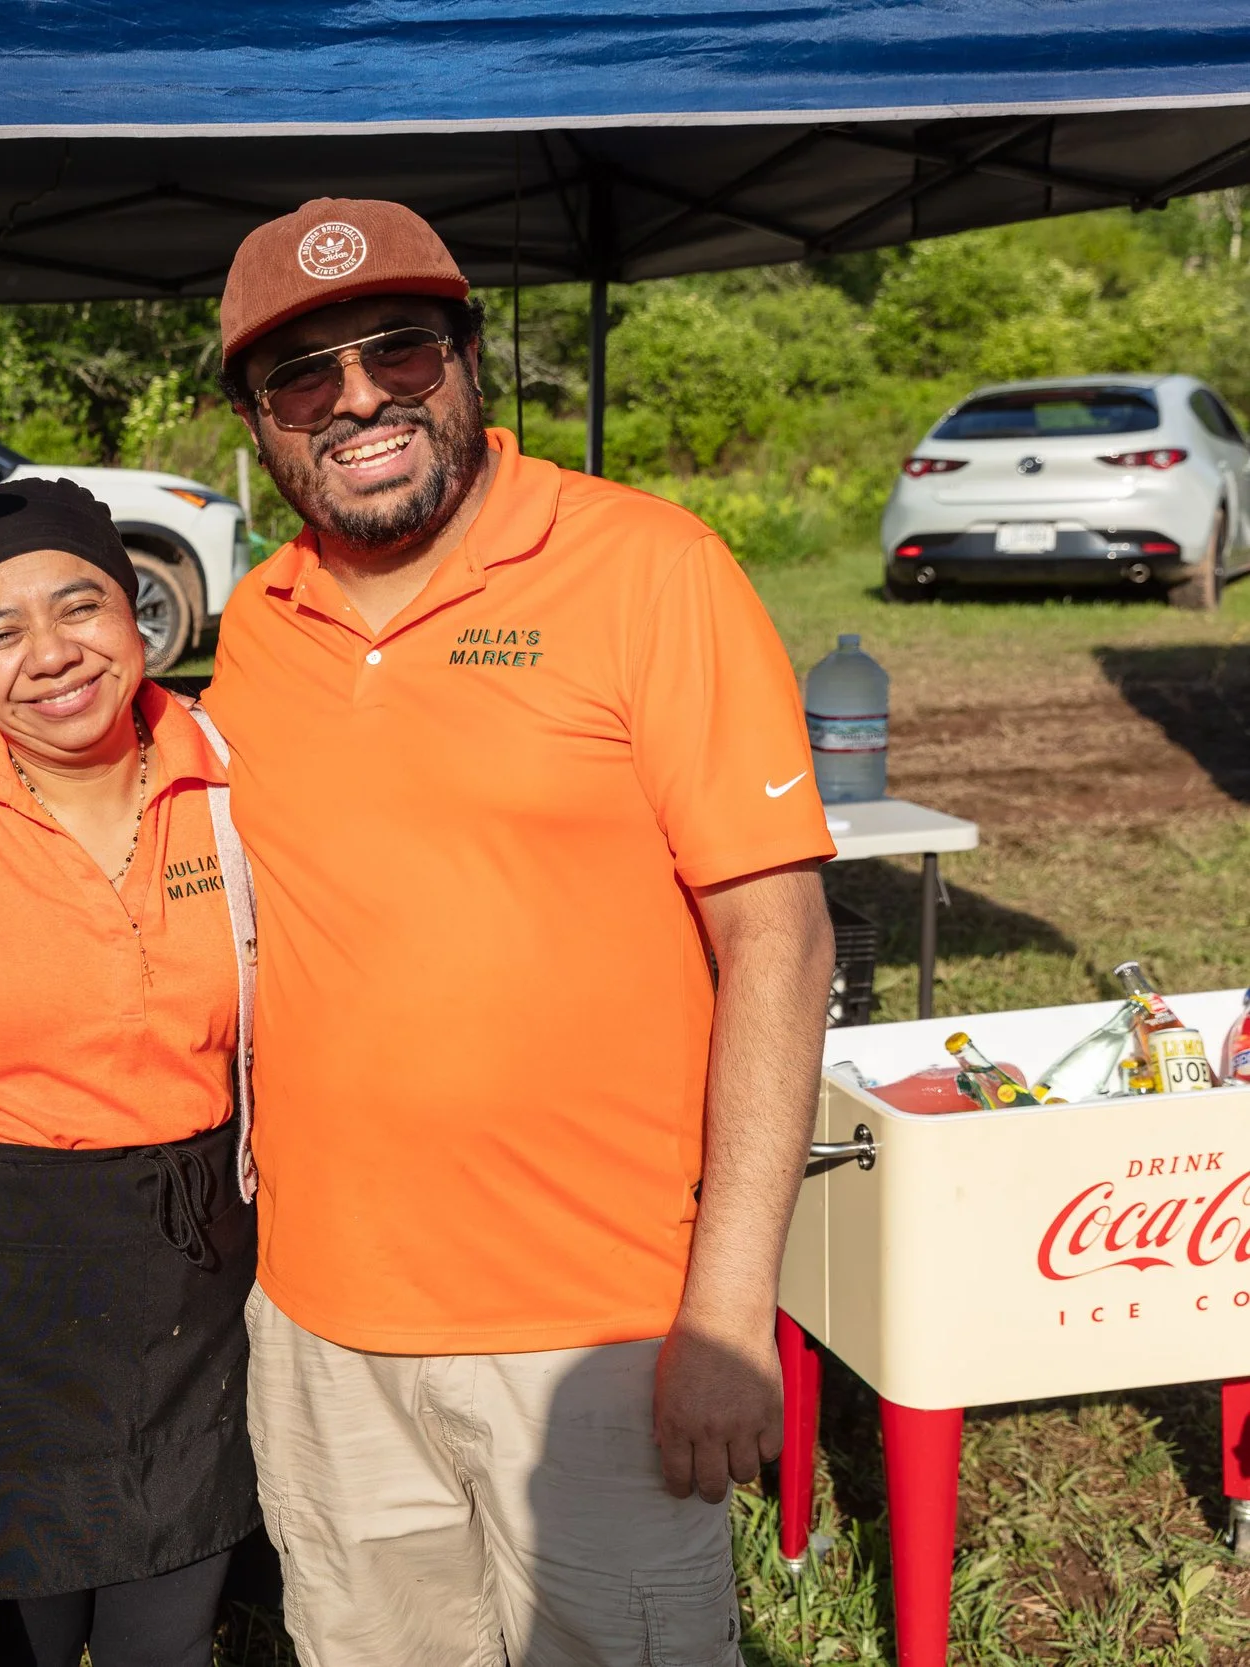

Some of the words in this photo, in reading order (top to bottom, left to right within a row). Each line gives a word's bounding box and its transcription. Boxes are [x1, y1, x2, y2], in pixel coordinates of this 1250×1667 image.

[302, 231, 320, 255] ADIDAS
[321, 225, 360, 241] ORIGINALS
[319, 251, 349, 263] adidas
[314, 267, 338, 275] SINCE
[457, 629, 541, 646] JULIA'S
[449, 650, 543, 667] MARKET
[1126, 1152, 1225, 1178] DRINK
[1059, 1303, 1141, 1326] ICE
[1195, 1291, 1250, 1311] CO
